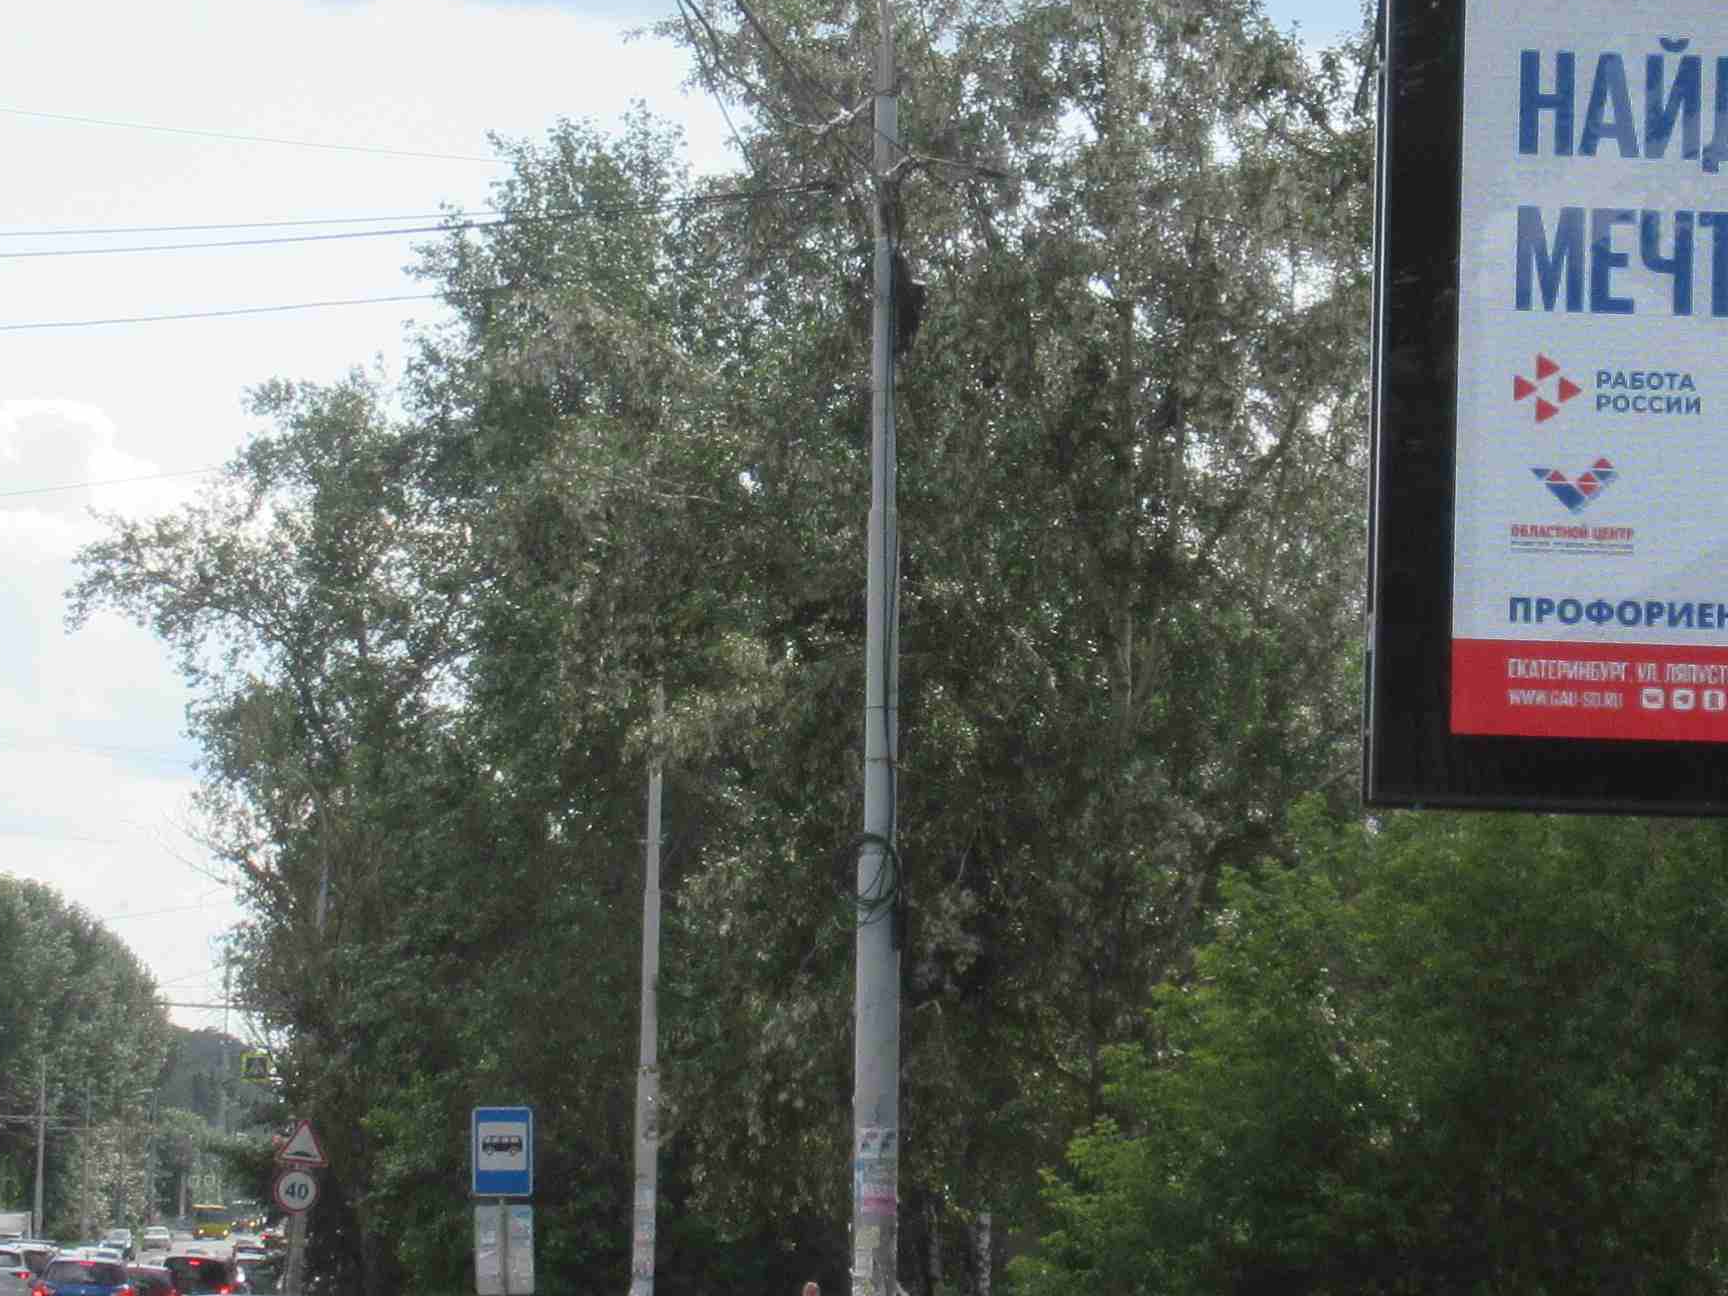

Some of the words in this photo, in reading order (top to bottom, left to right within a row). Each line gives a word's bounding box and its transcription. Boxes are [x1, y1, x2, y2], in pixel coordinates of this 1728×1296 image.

[1595, 370, 1697, 392] РАБОТА
[1595, 394, 1702, 415] РОССИИ
[285, 1183, 309, 1200] 40
